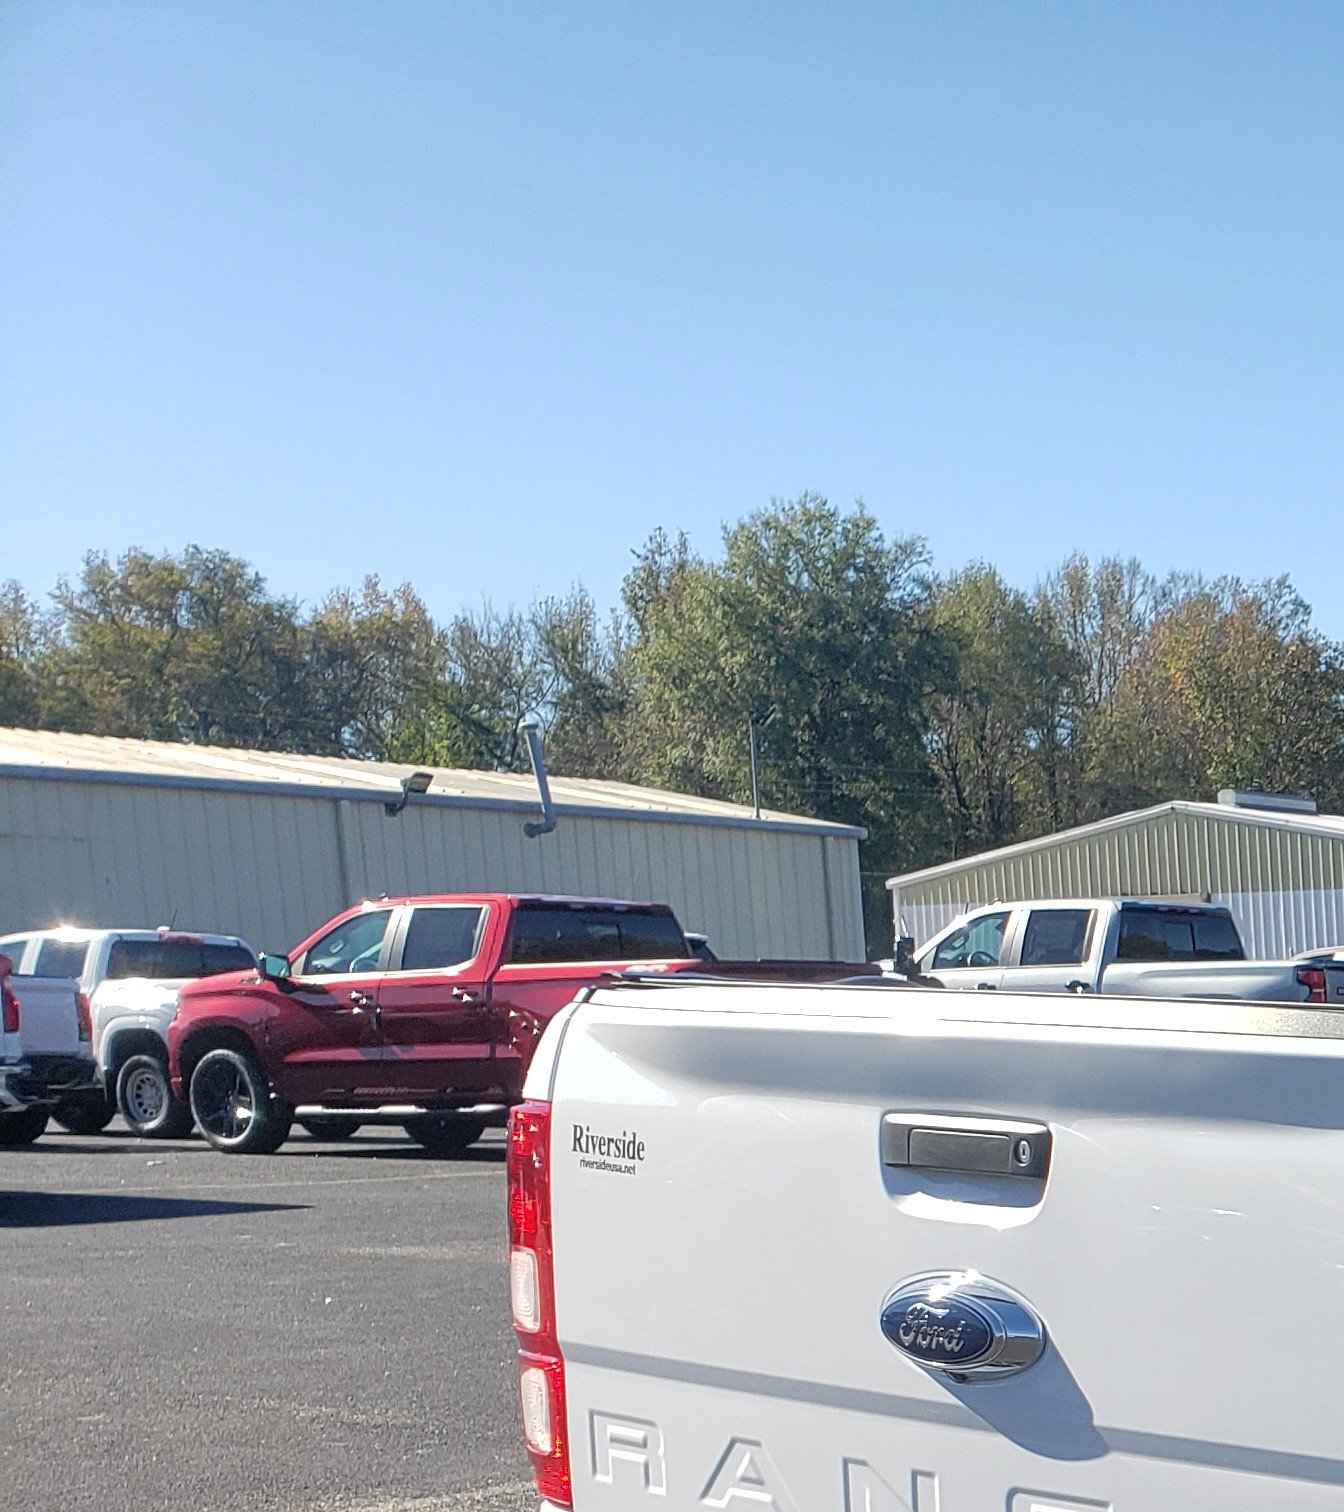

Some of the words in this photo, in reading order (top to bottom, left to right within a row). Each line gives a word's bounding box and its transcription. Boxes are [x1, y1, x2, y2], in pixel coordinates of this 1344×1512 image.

[572, 1123, 646, 1161] Riverside
[579, 1157, 636, 1175] riversideusa.net
[899, 1302, 967, 1353] Ford
